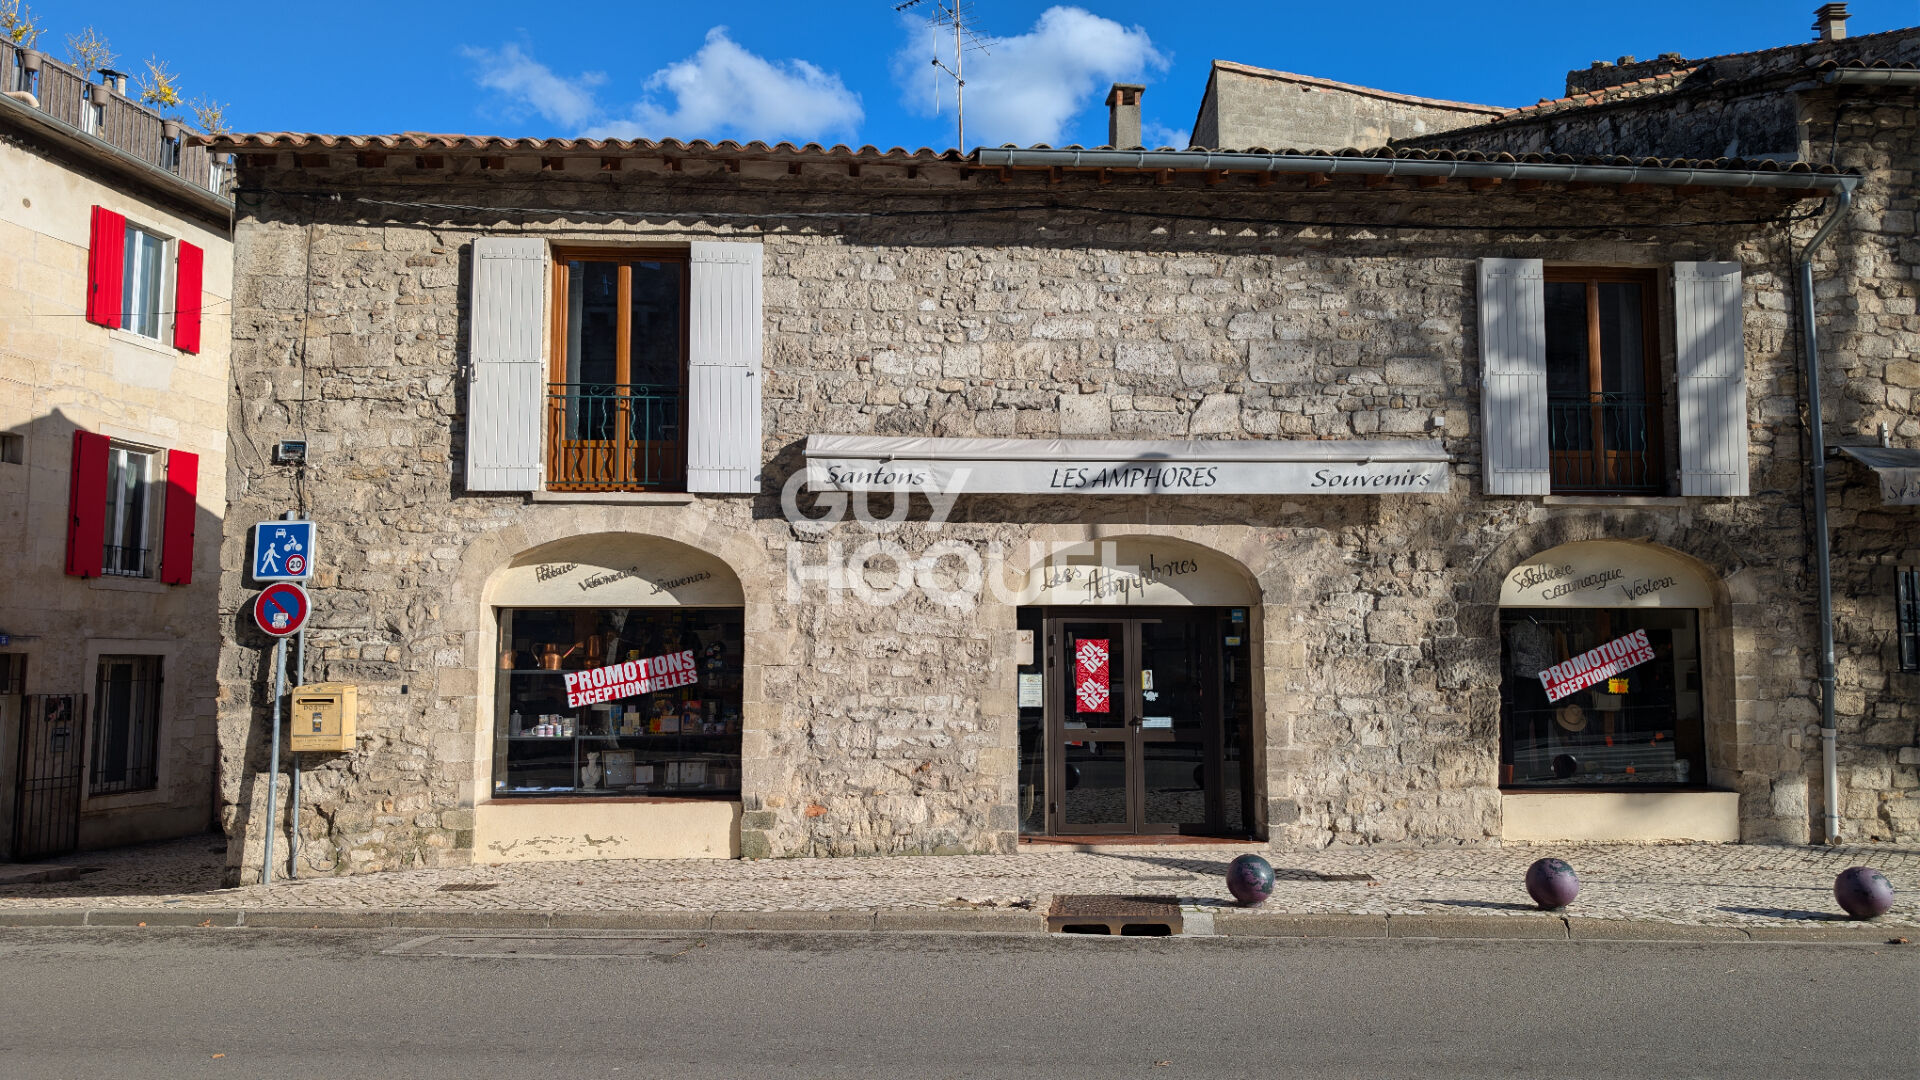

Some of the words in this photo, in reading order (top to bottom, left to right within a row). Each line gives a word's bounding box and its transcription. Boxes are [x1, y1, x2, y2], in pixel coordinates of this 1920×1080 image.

[824, 465, 926, 486] Santons
[1050, 467, 1089, 489] LES
[1091, 466, 1218, 489] AMPHORES
[1311, 469, 1432, 488] Souvenirs
[290, 560, 302, 569] 20
[564, 650, 697, 693] PROMOTIONS
[1538, 628, 1650, 689] PROMOTIONS
[567, 670, 699, 708] EXCEPTIONNELLES
[1545, 647, 1656, 704] EXCEPTIONNELLES
